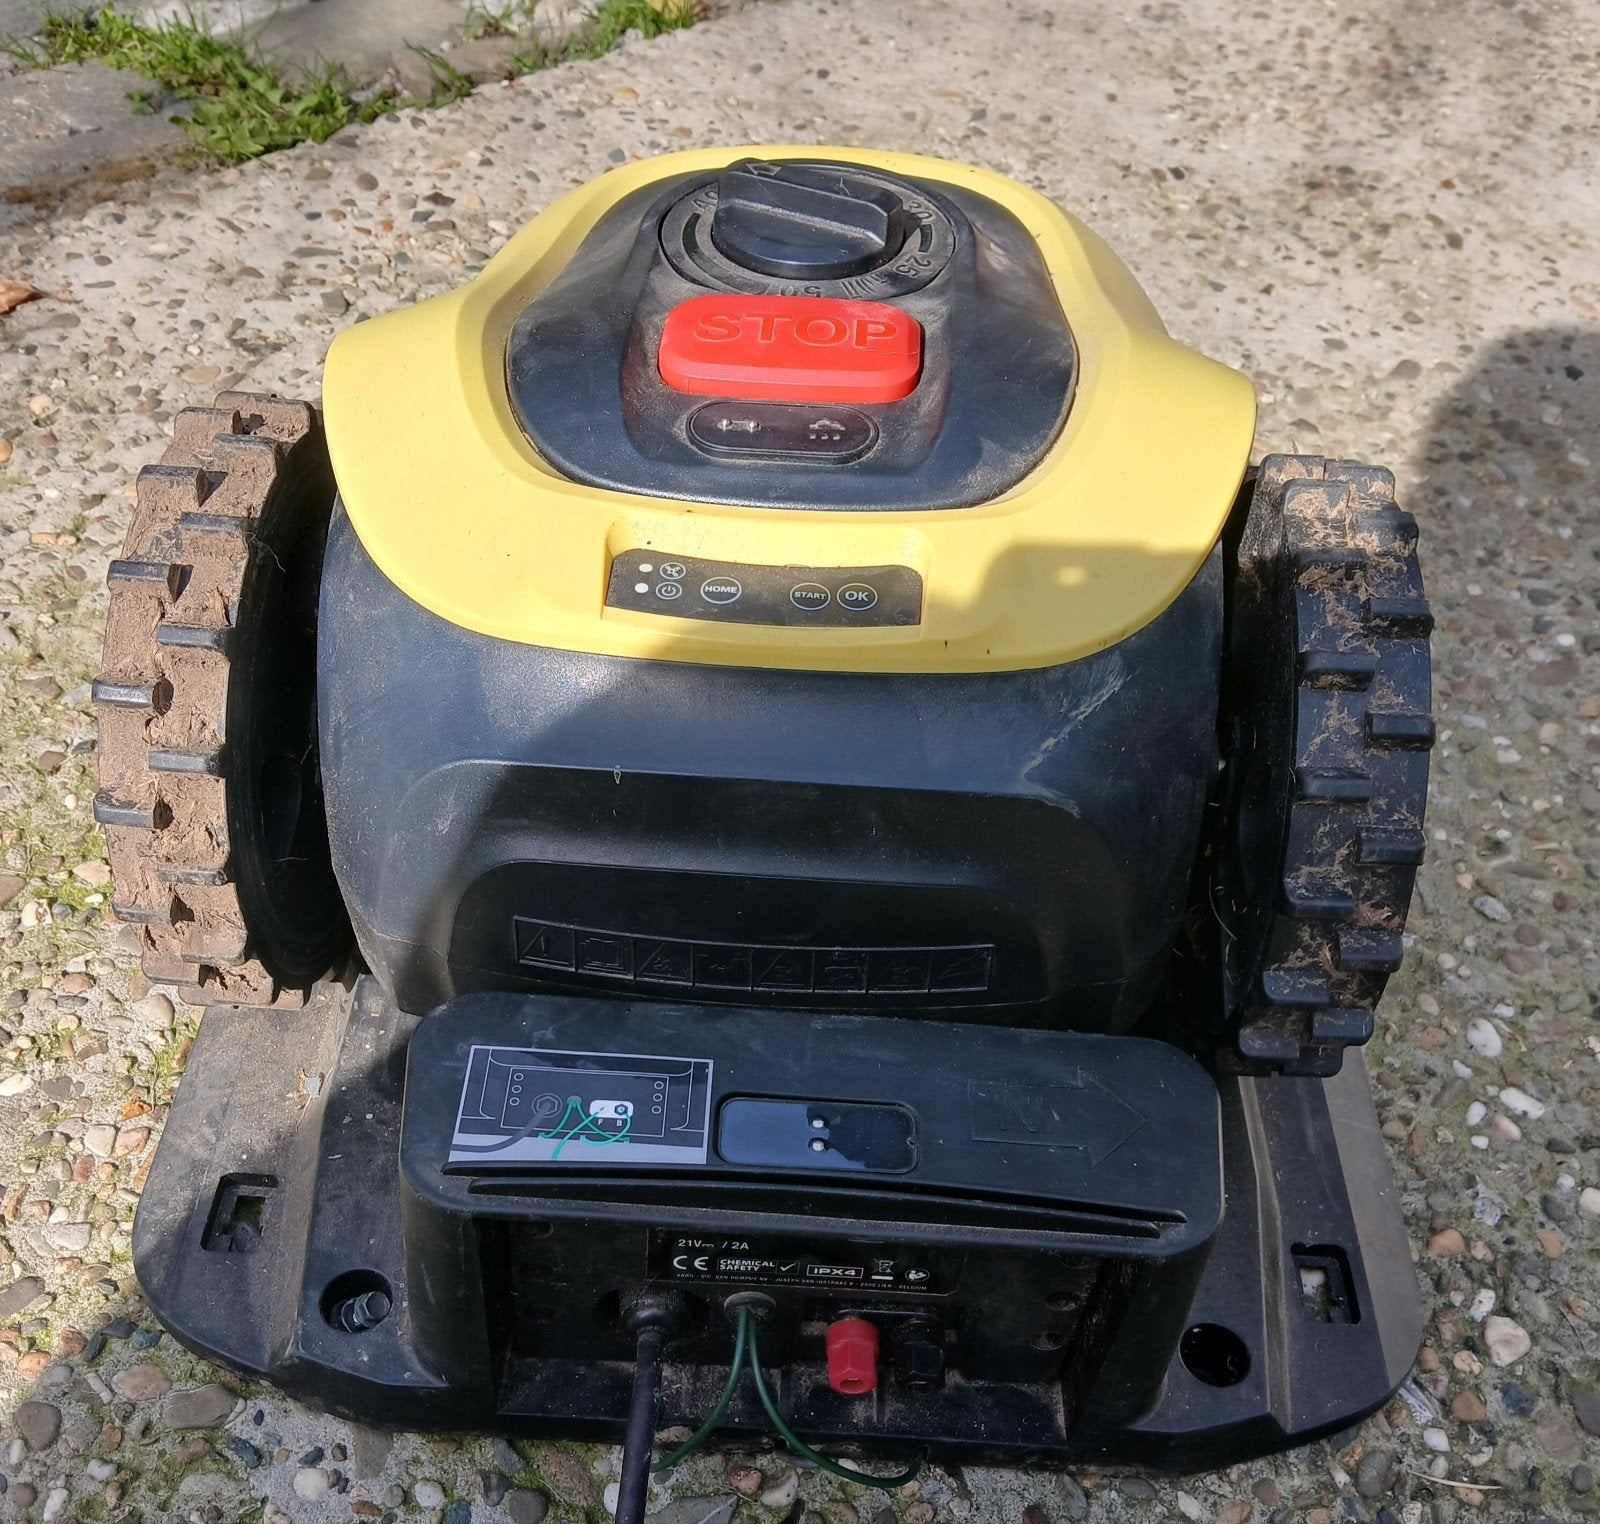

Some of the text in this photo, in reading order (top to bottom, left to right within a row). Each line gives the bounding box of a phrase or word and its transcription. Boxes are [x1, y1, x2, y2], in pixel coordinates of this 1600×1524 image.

[893, 253, 933, 279] 25
[695, 312, 898, 350] STOP
[704, 585, 738, 594] HOME
[794, 590, 826, 600] START
[845, 590, 869, 602] OK
[597, 1118, 604, 1126] F
[616, 1119, 623, 1127] B
[731, 1241, 749, 1250] 2A
[673, 1255, 709, 1271] CE
[720, 1258, 776, 1267] CHEMICAL
[719, 1264, 760, 1272] SAFETY
[813, 1267, 857, 1276] IPX4
